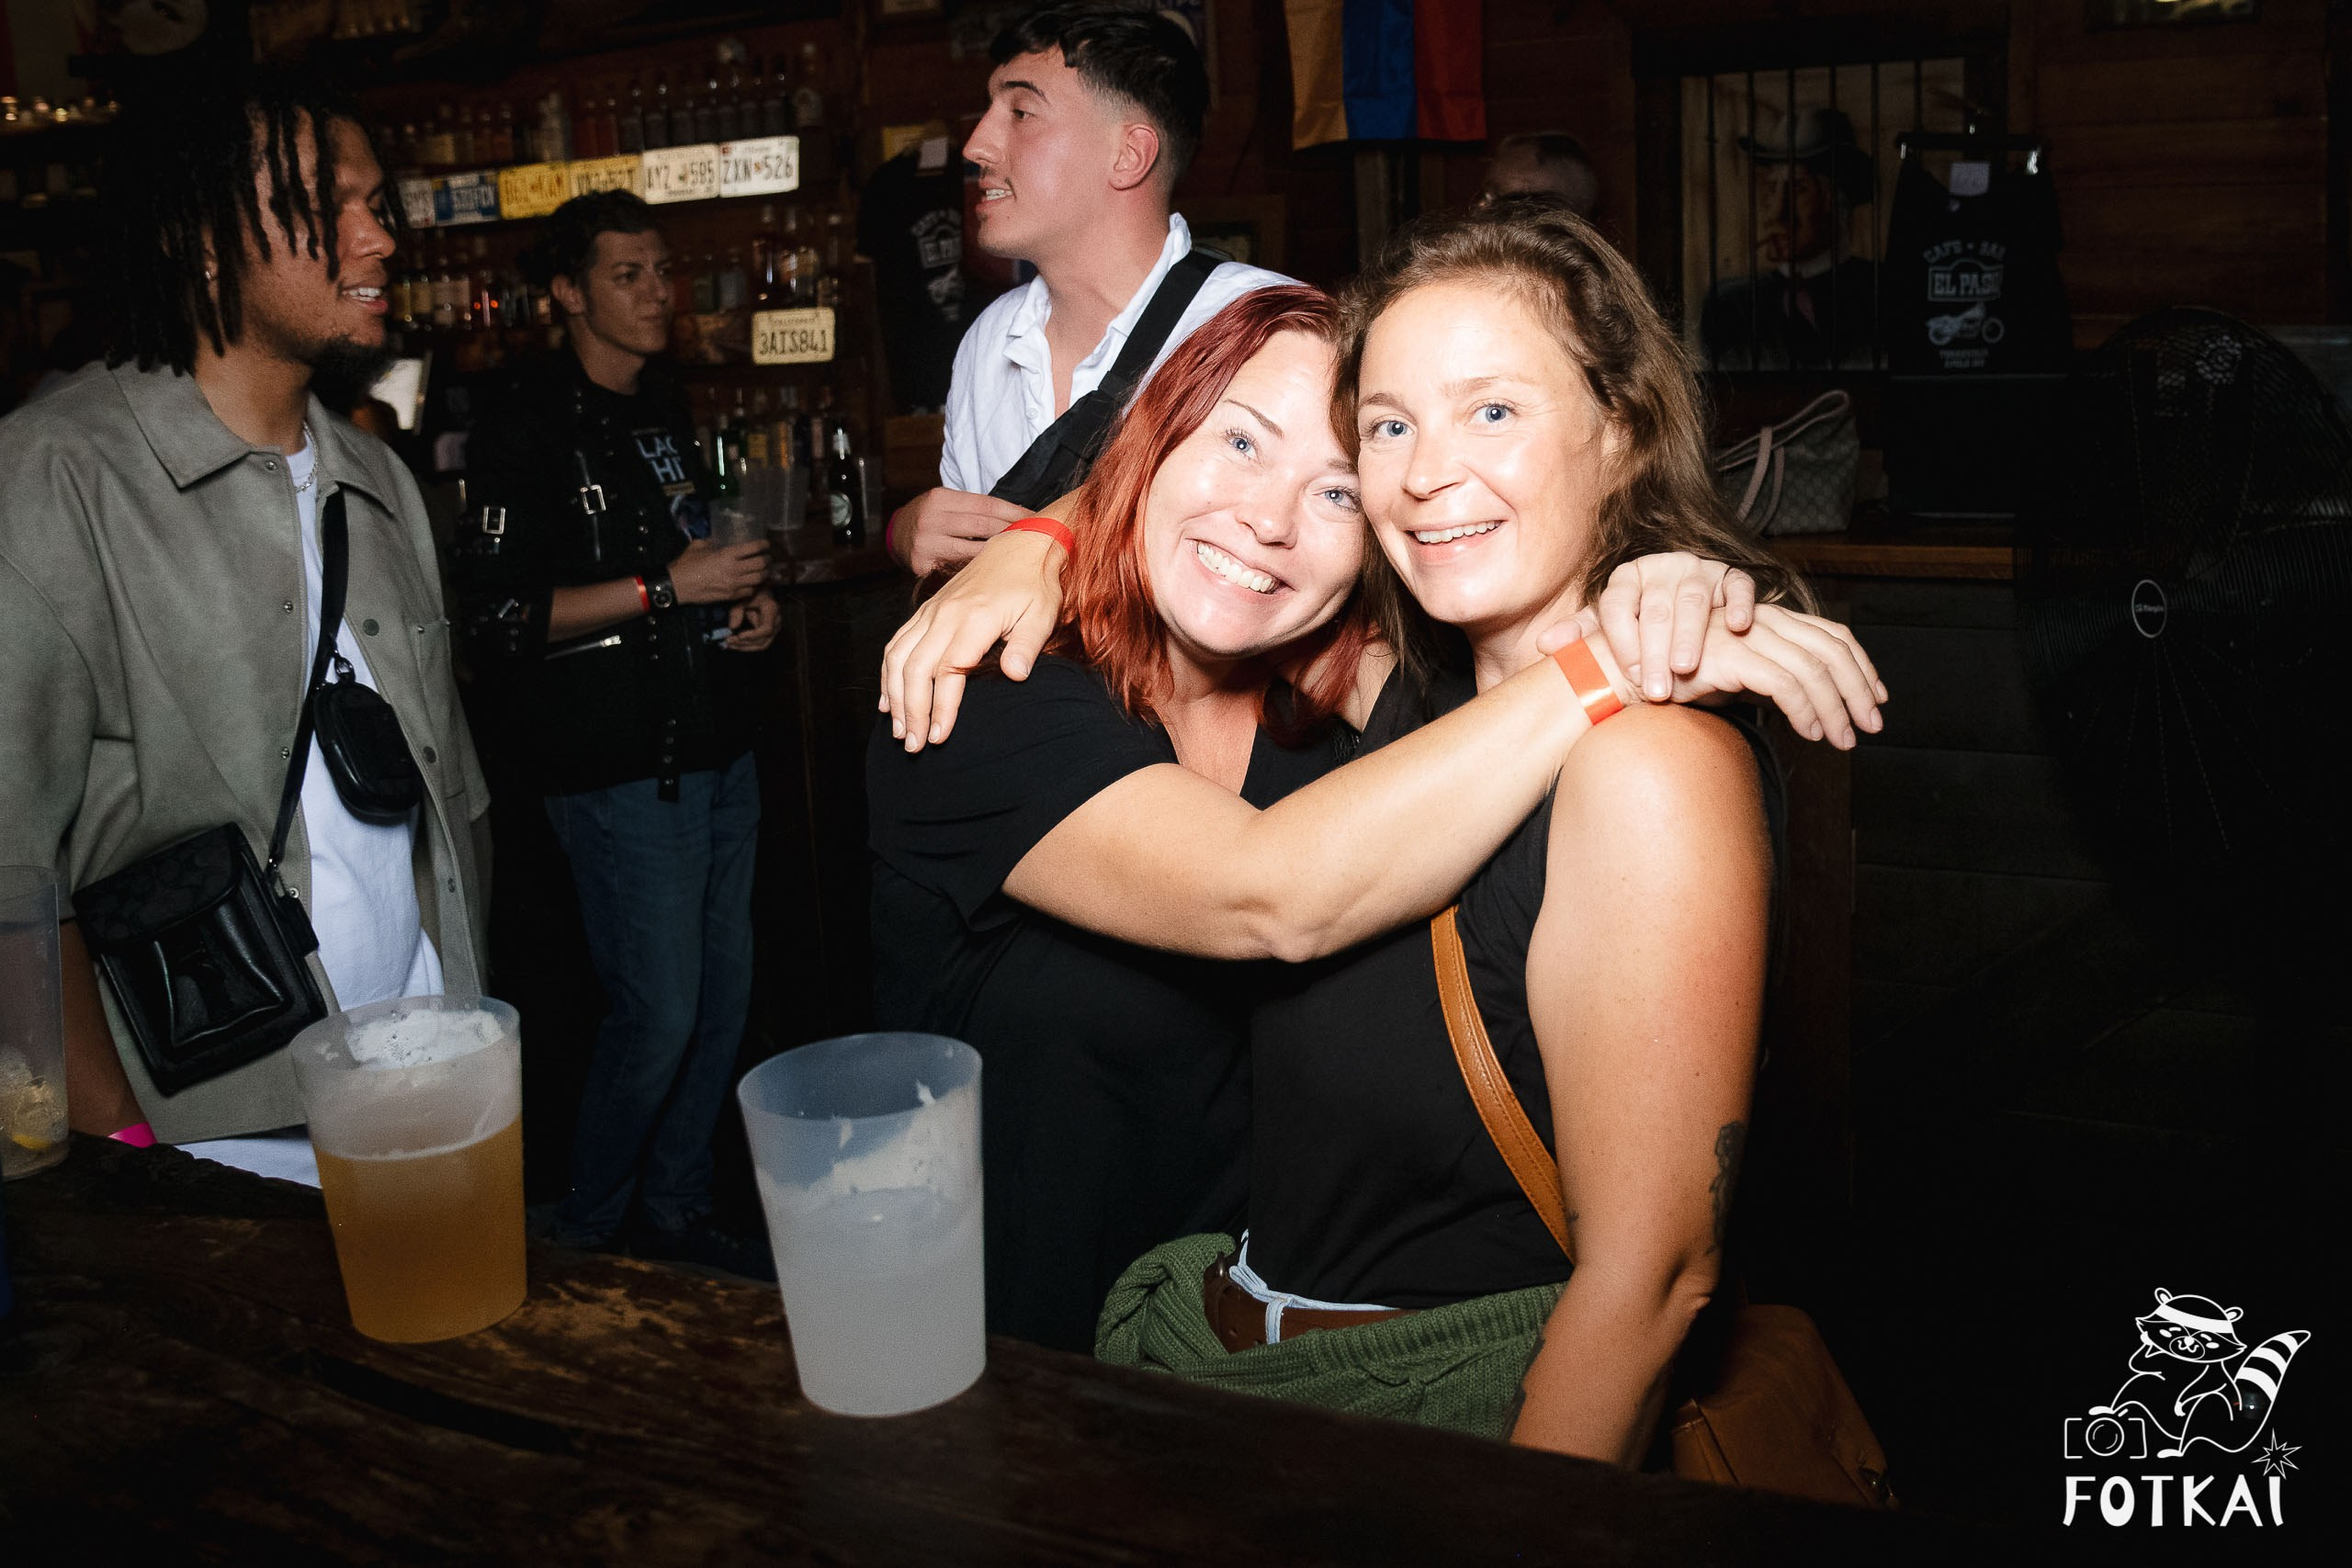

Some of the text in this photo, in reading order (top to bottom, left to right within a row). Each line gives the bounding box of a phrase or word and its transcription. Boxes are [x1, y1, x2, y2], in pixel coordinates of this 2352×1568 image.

[722, 154, 794, 185] ZXN 526
[1933, 273, 1957, 296] EL
[759, 329, 829, 355] 3AIS841
